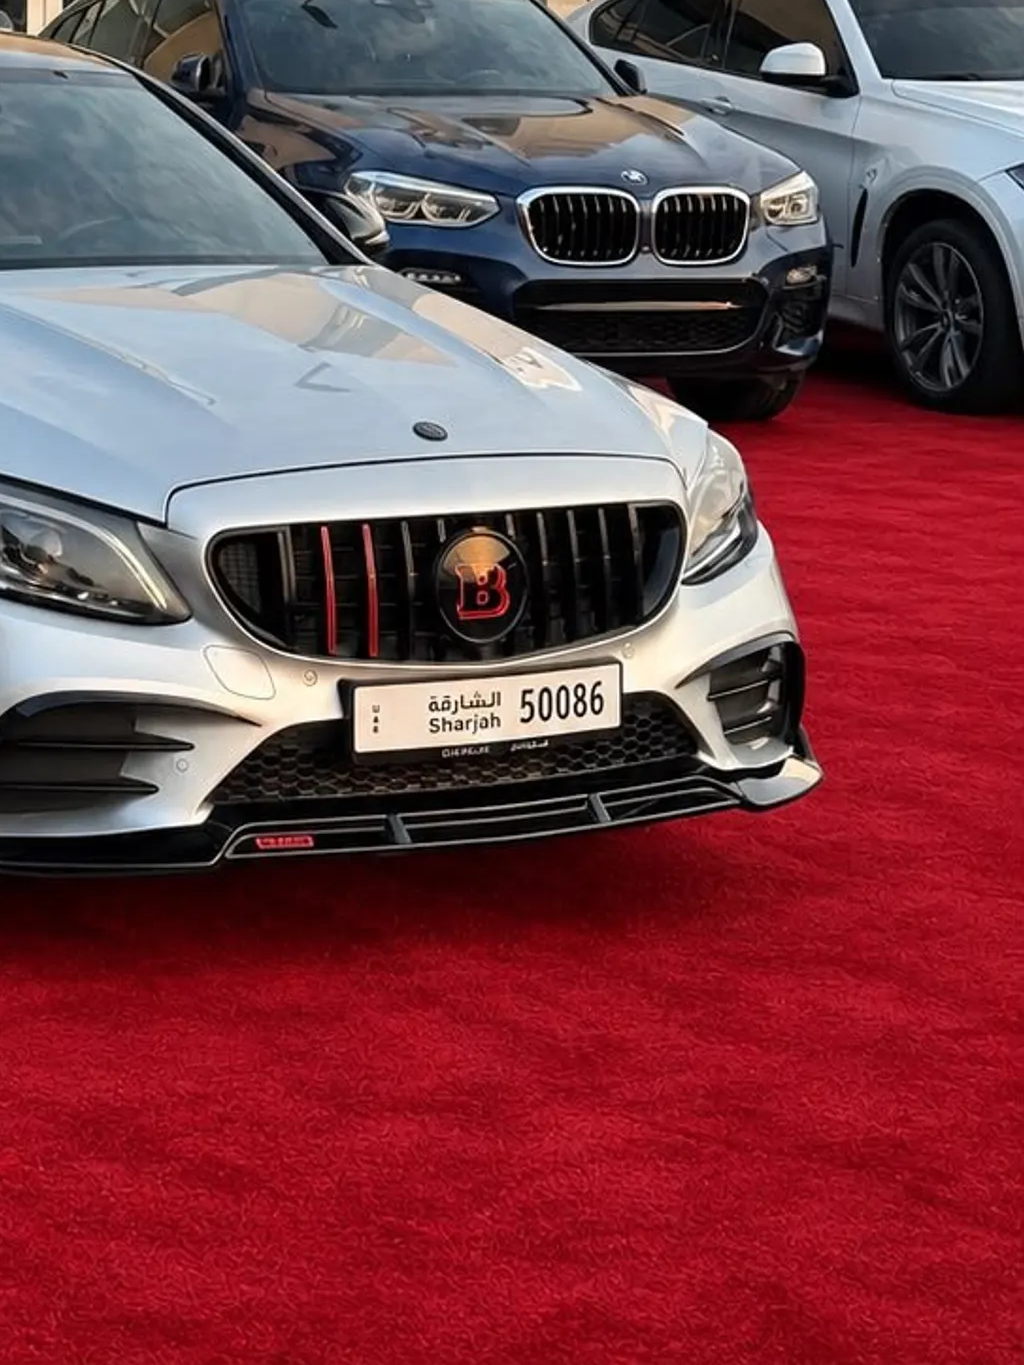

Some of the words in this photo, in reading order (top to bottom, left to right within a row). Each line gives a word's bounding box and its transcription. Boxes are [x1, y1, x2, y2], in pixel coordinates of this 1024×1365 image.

[428, 691, 501, 715] الشارقة
[519, 680, 606, 724] 50086
[428, 712, 501, 735] Sharjah
